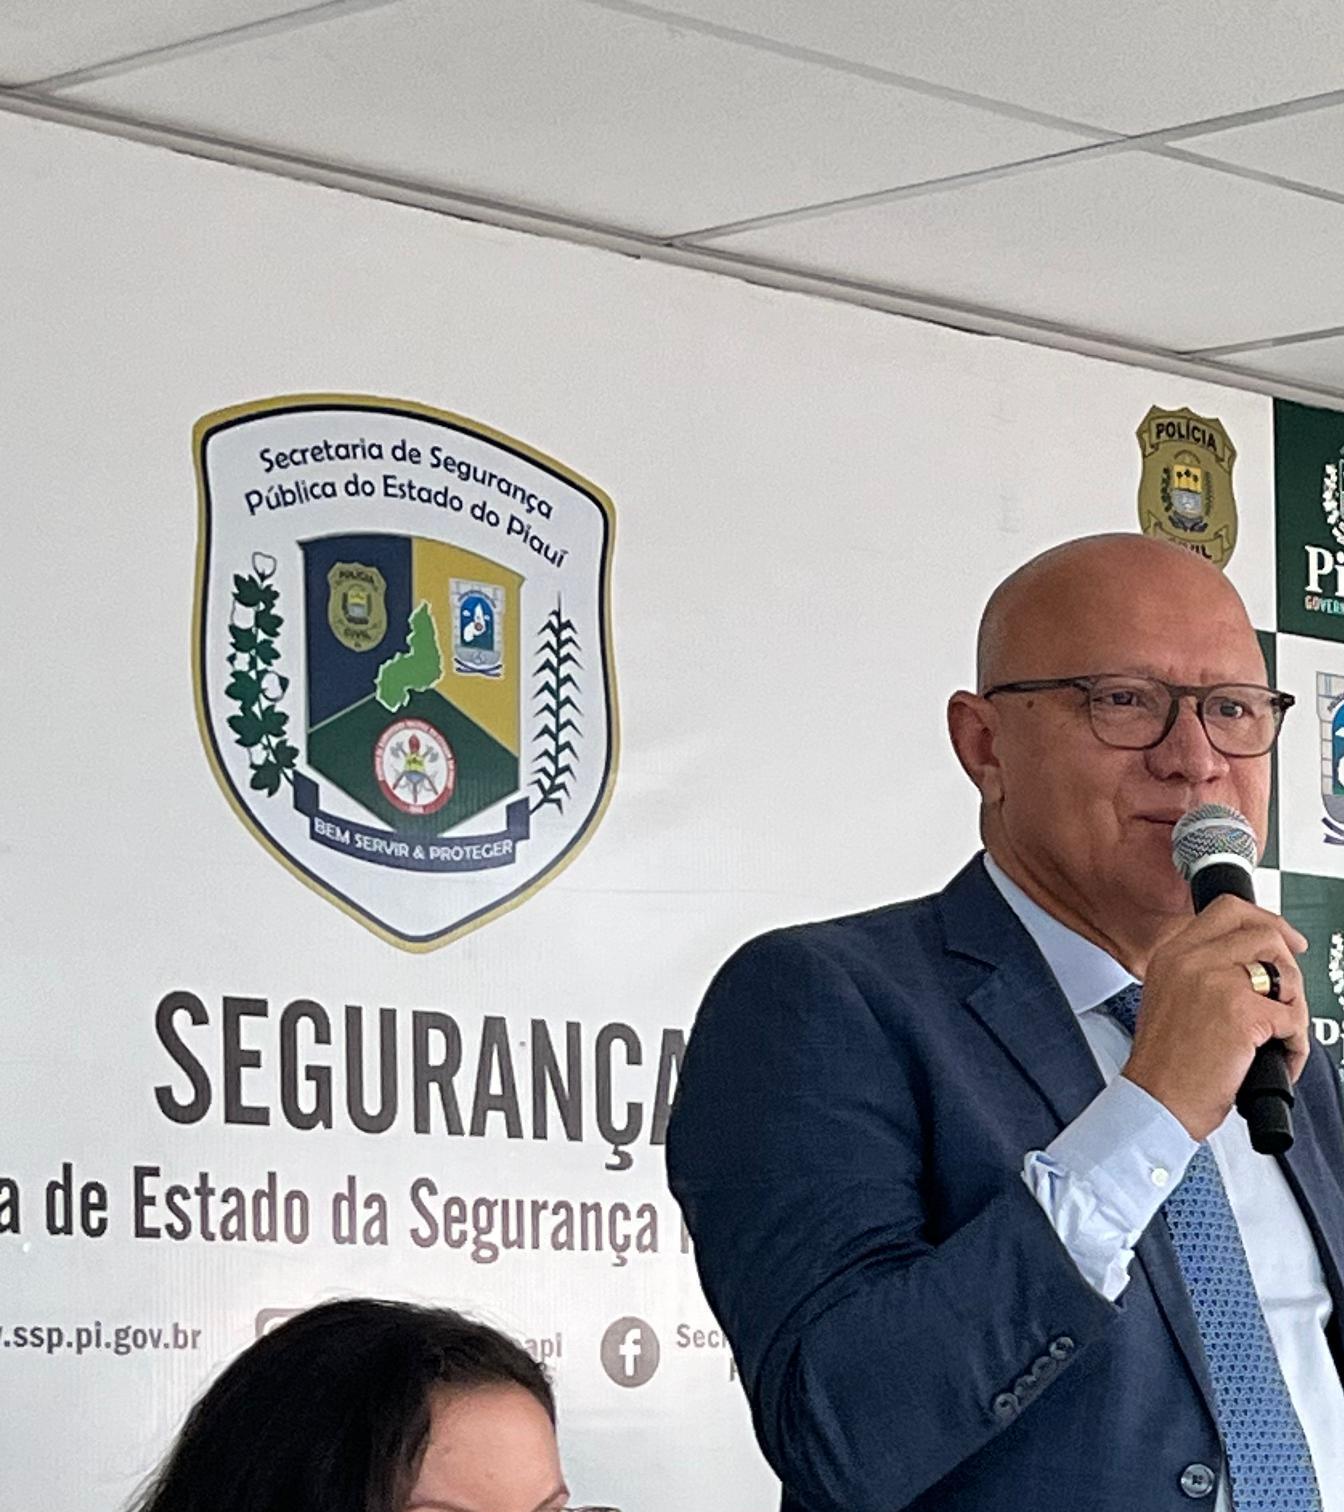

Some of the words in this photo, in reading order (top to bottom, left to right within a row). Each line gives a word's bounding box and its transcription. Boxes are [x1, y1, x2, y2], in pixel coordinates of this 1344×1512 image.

[1156, 421, 1217, 451] POLÍCIA
[259, 438, 383, 473] Secretaria
[391, 439, 421, 464] de
[429, 446, 553, 519] Segurança
[244, 478, 337, 515] Pública
[344, 473, 375, 497] do
[382, 475, 463, 512] Estado
[470, 500, 500, 527] do
[506, 514, 568, 568] Piauí
[314, 818, 350, 845] BEM
[354, 834, 409, 858] SERVIR
[412, 846, 425, 859] &
[429, 840, 513, 861] PROTEGER
[45, 1162, 108, 1240] de
[133, 1165, 310, 1245] Estado
[331, 1174, 389, 1246] da
[409, 1177, 658, 1267] Segurança
[0, 1321, 201, 1355] .ssp.pi.gov.br
